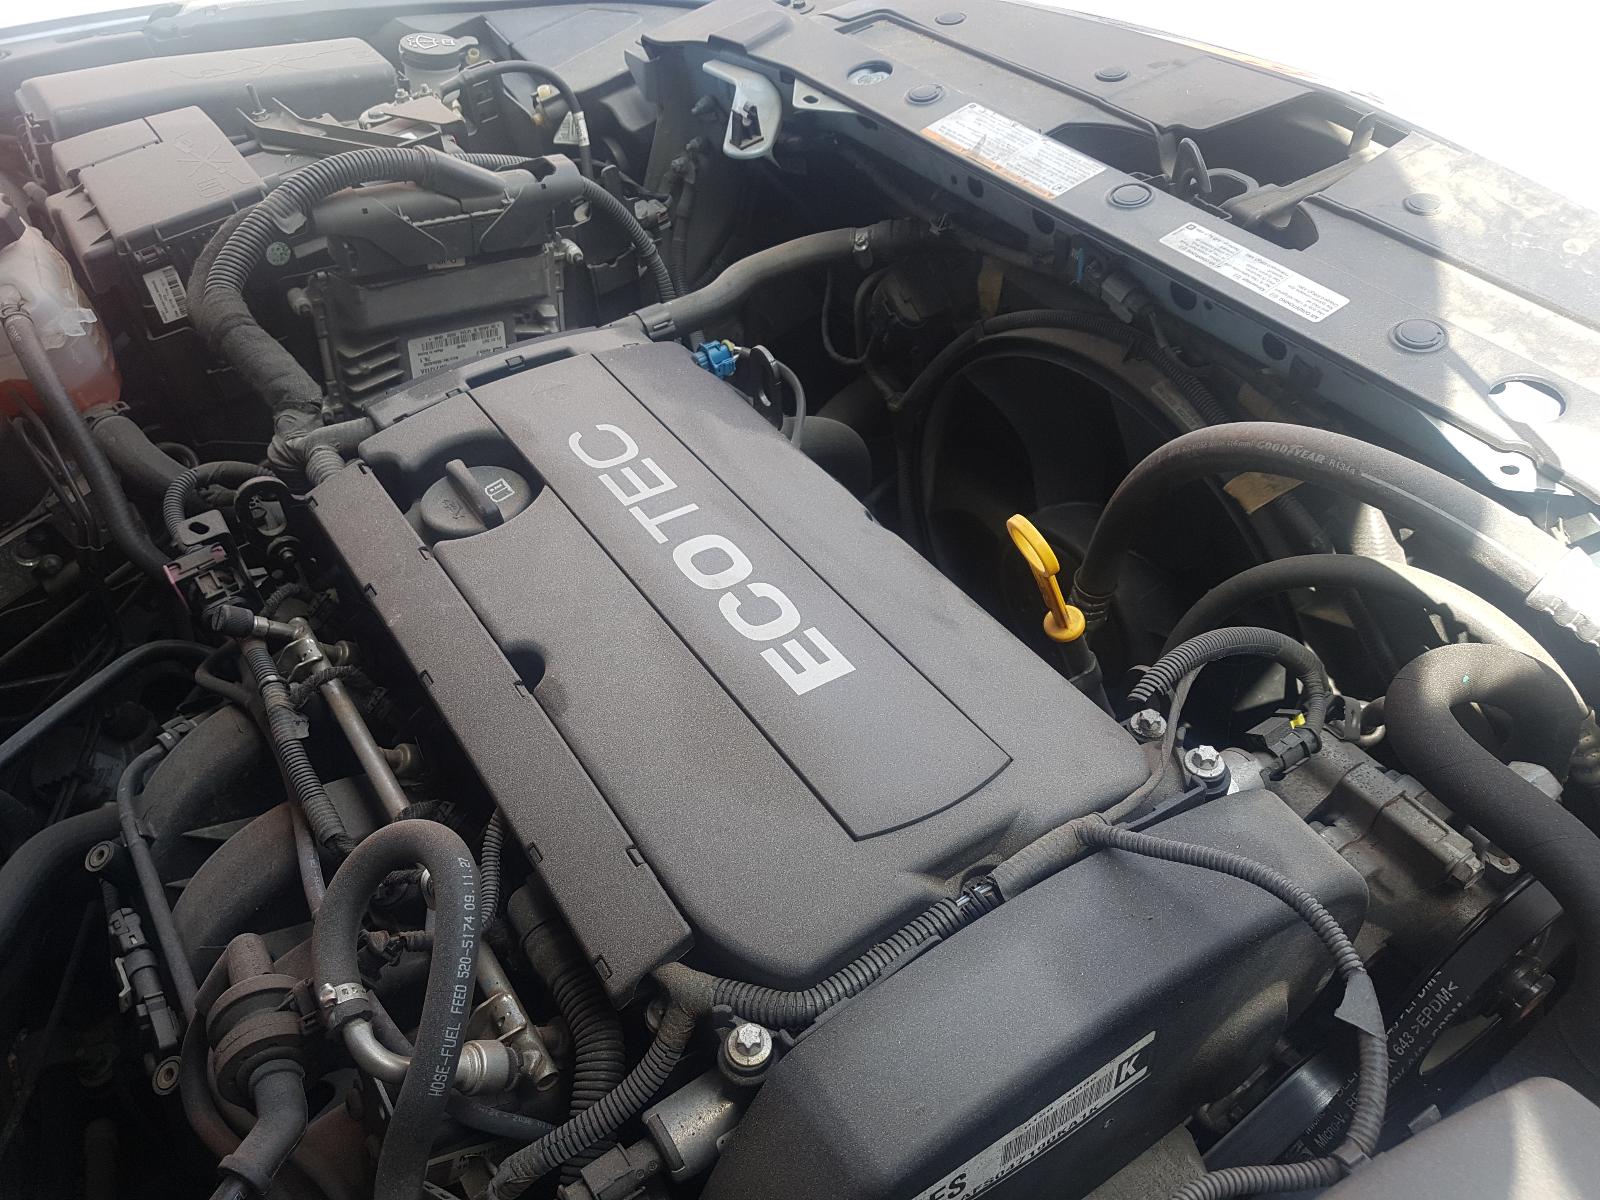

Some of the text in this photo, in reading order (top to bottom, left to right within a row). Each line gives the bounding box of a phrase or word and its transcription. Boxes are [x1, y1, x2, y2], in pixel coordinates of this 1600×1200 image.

[568, 423, 856, 696] ECOTEC
[428, 856, 477, 1097] HOSE-FUEL FEED 520-5174 09.11.27
[1393, 1030, 1415, 1057] 643
